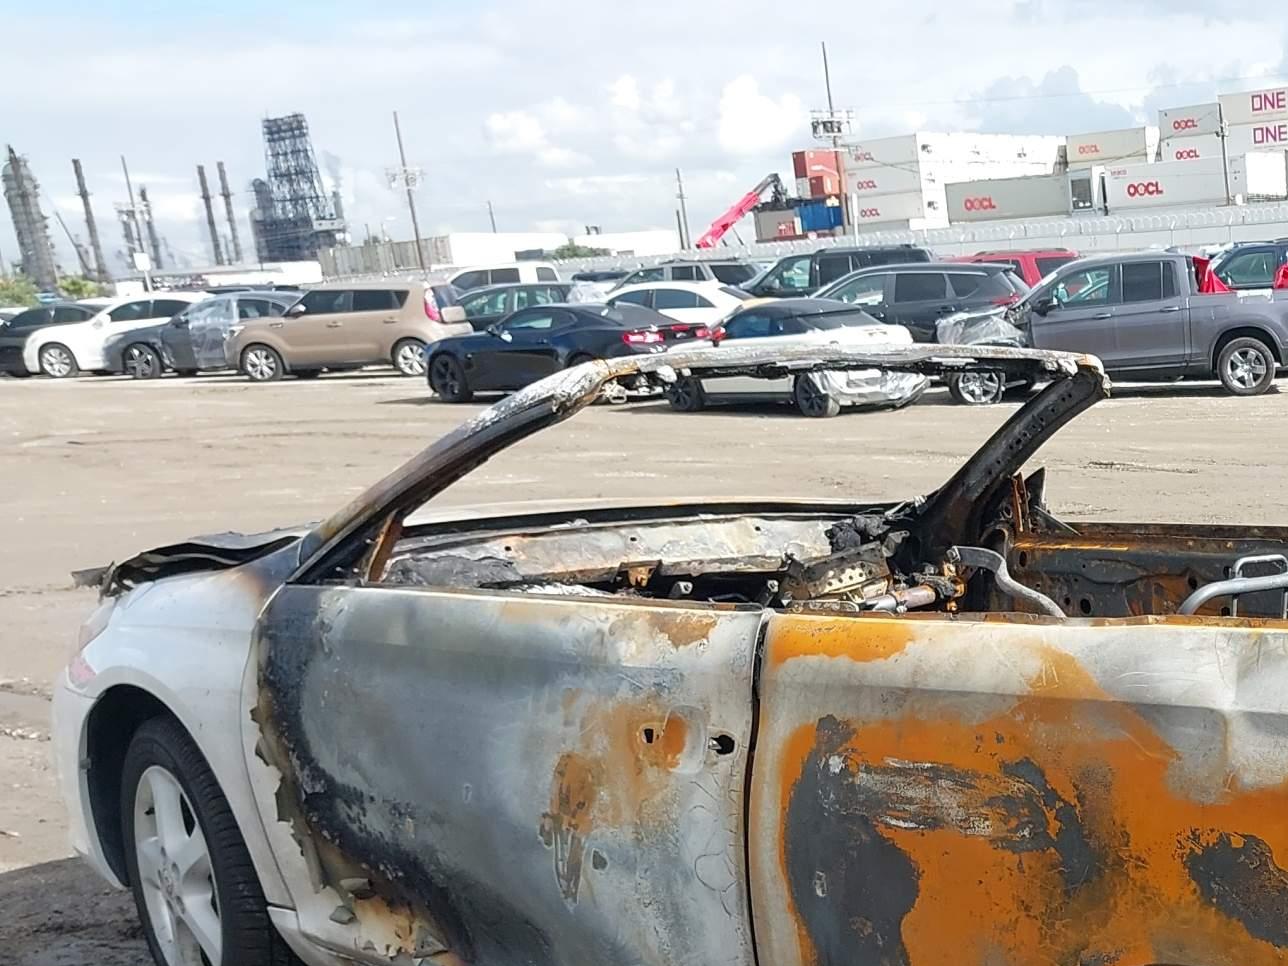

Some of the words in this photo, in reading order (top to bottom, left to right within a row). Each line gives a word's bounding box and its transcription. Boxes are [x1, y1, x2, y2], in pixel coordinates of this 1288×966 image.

[1251, 91, 1286, 112] ONE
[1173, 118, 1198, 130] OOCL
[1253, 125, 1288, 144] ONE
[1079, 145, 1099, 154] OOCL
[1176, 150, 1199, 159] OOCL
[857, 180, 877, 190] OOCL
[1127, 181, 1163, 197] OOCL
[964, 196, 996, 211] OOCL
[861, 208, 880, 218] OOCL
